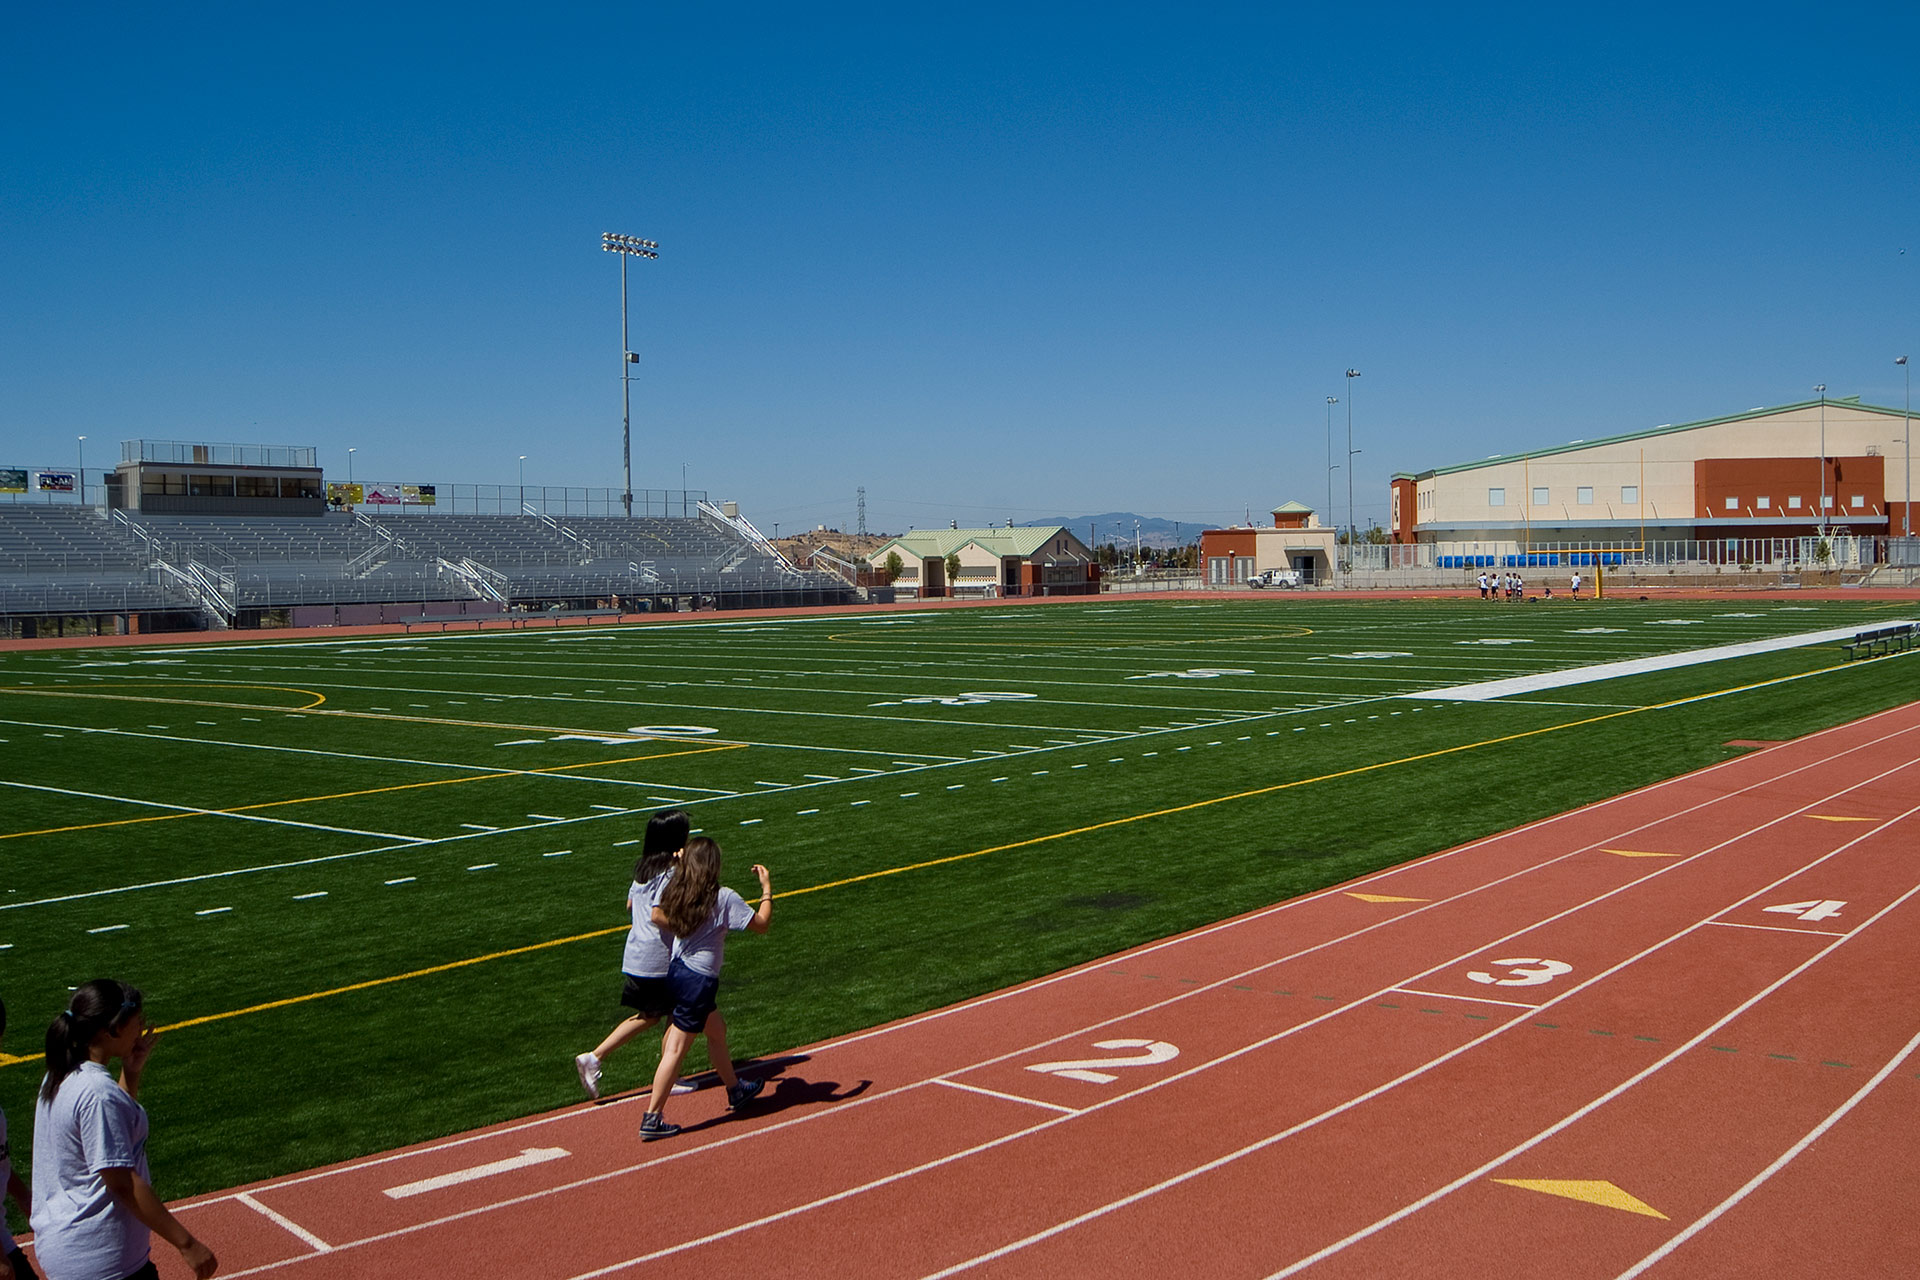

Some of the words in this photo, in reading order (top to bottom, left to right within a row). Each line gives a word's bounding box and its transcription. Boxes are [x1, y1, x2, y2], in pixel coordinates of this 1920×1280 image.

[548, 725, 720, 745] 10
[1762, 900, 1848, 922] 4
[1466, 957, 1574, 987] 3
[1023, 1038, 1180, 1085] 2
[381, 1146, 573, 1200] 1
